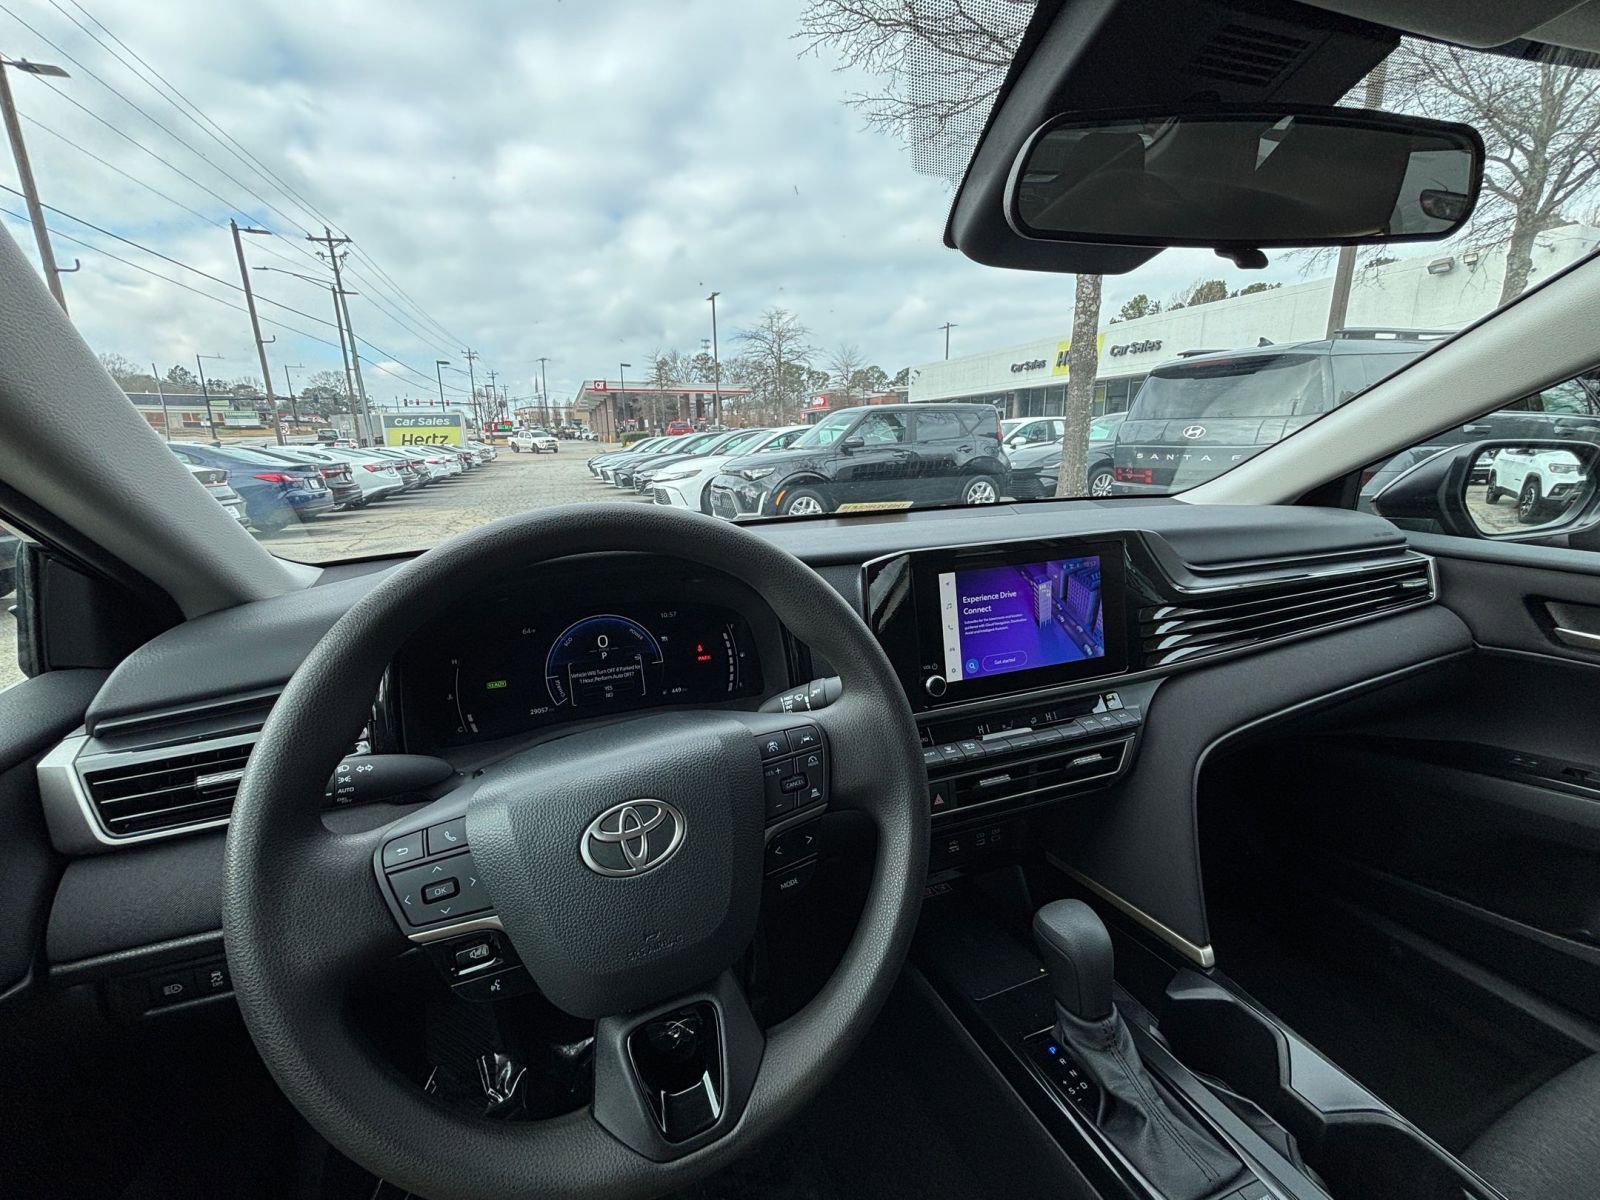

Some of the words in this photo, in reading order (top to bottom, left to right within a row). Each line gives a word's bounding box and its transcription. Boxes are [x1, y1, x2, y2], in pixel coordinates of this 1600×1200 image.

[1110, 344, 1129, 357] Car
[1129, 339, 1163, 355] Sales
[1011, 362, 1025, 373] Car
[1024, 359, 1047, 371] Sales
[394, 417, 415, 426] Car
[417, 417, 450, 426] Sales
[401, 433, 449, 446] Hertz
[1136, 453, 1212, 461] SANTA
[962, 593, 999, 604] Experience
[1000, 590, 1017, 599] Drive
[963, 605, 992, 615] Connect
[601, 651, 608, 660] P
[530, 707, 548, 715] 29057
[337, 786, 355, 794] AUTO
[780, 877, 799, 891] MODE
[434, 885, 447, 896] OK
[1048, 1046, 1056, 1055] P
[1069, 1069, 1078, 1077] N
